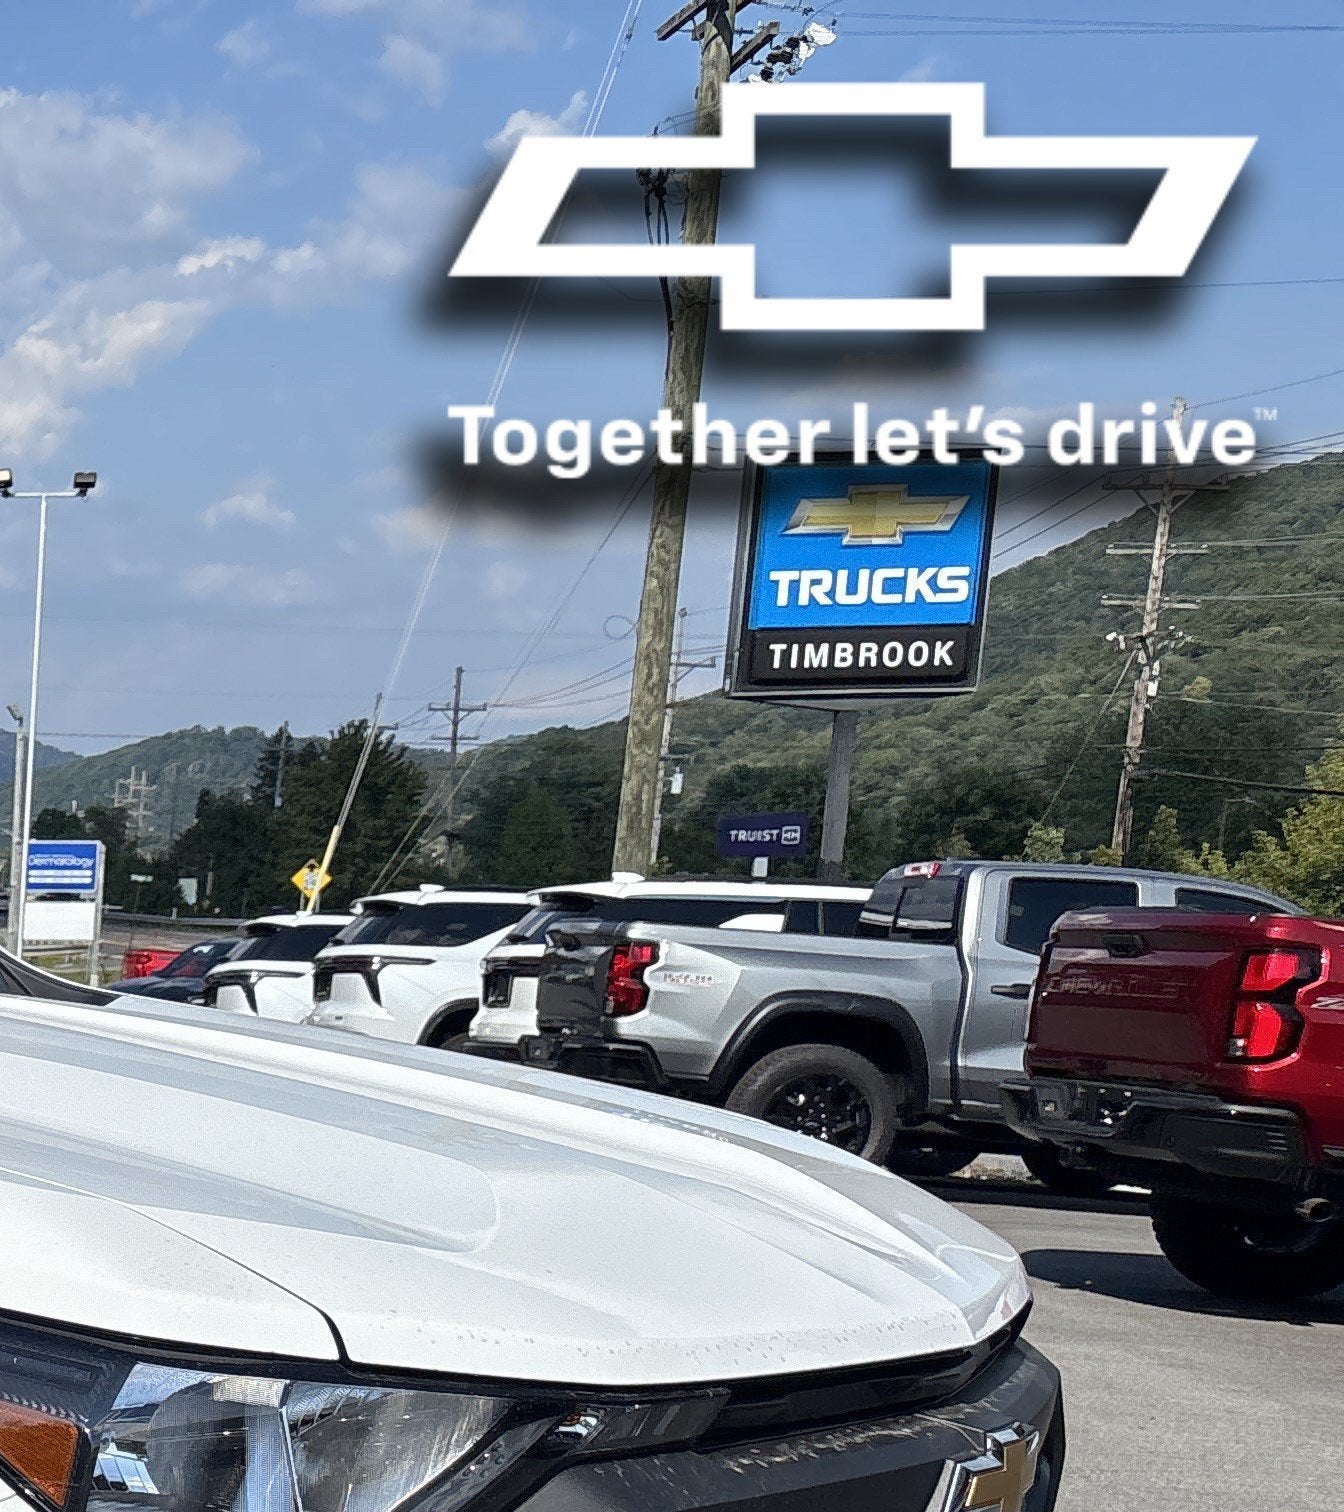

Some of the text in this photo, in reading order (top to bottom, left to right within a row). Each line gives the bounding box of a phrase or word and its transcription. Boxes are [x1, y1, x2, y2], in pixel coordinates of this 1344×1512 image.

[768, 566, 971, 607] TRUCKS
[768, 640, 955, 669] TIMBROOK
[729, 829, 780, 842] TRUIST
